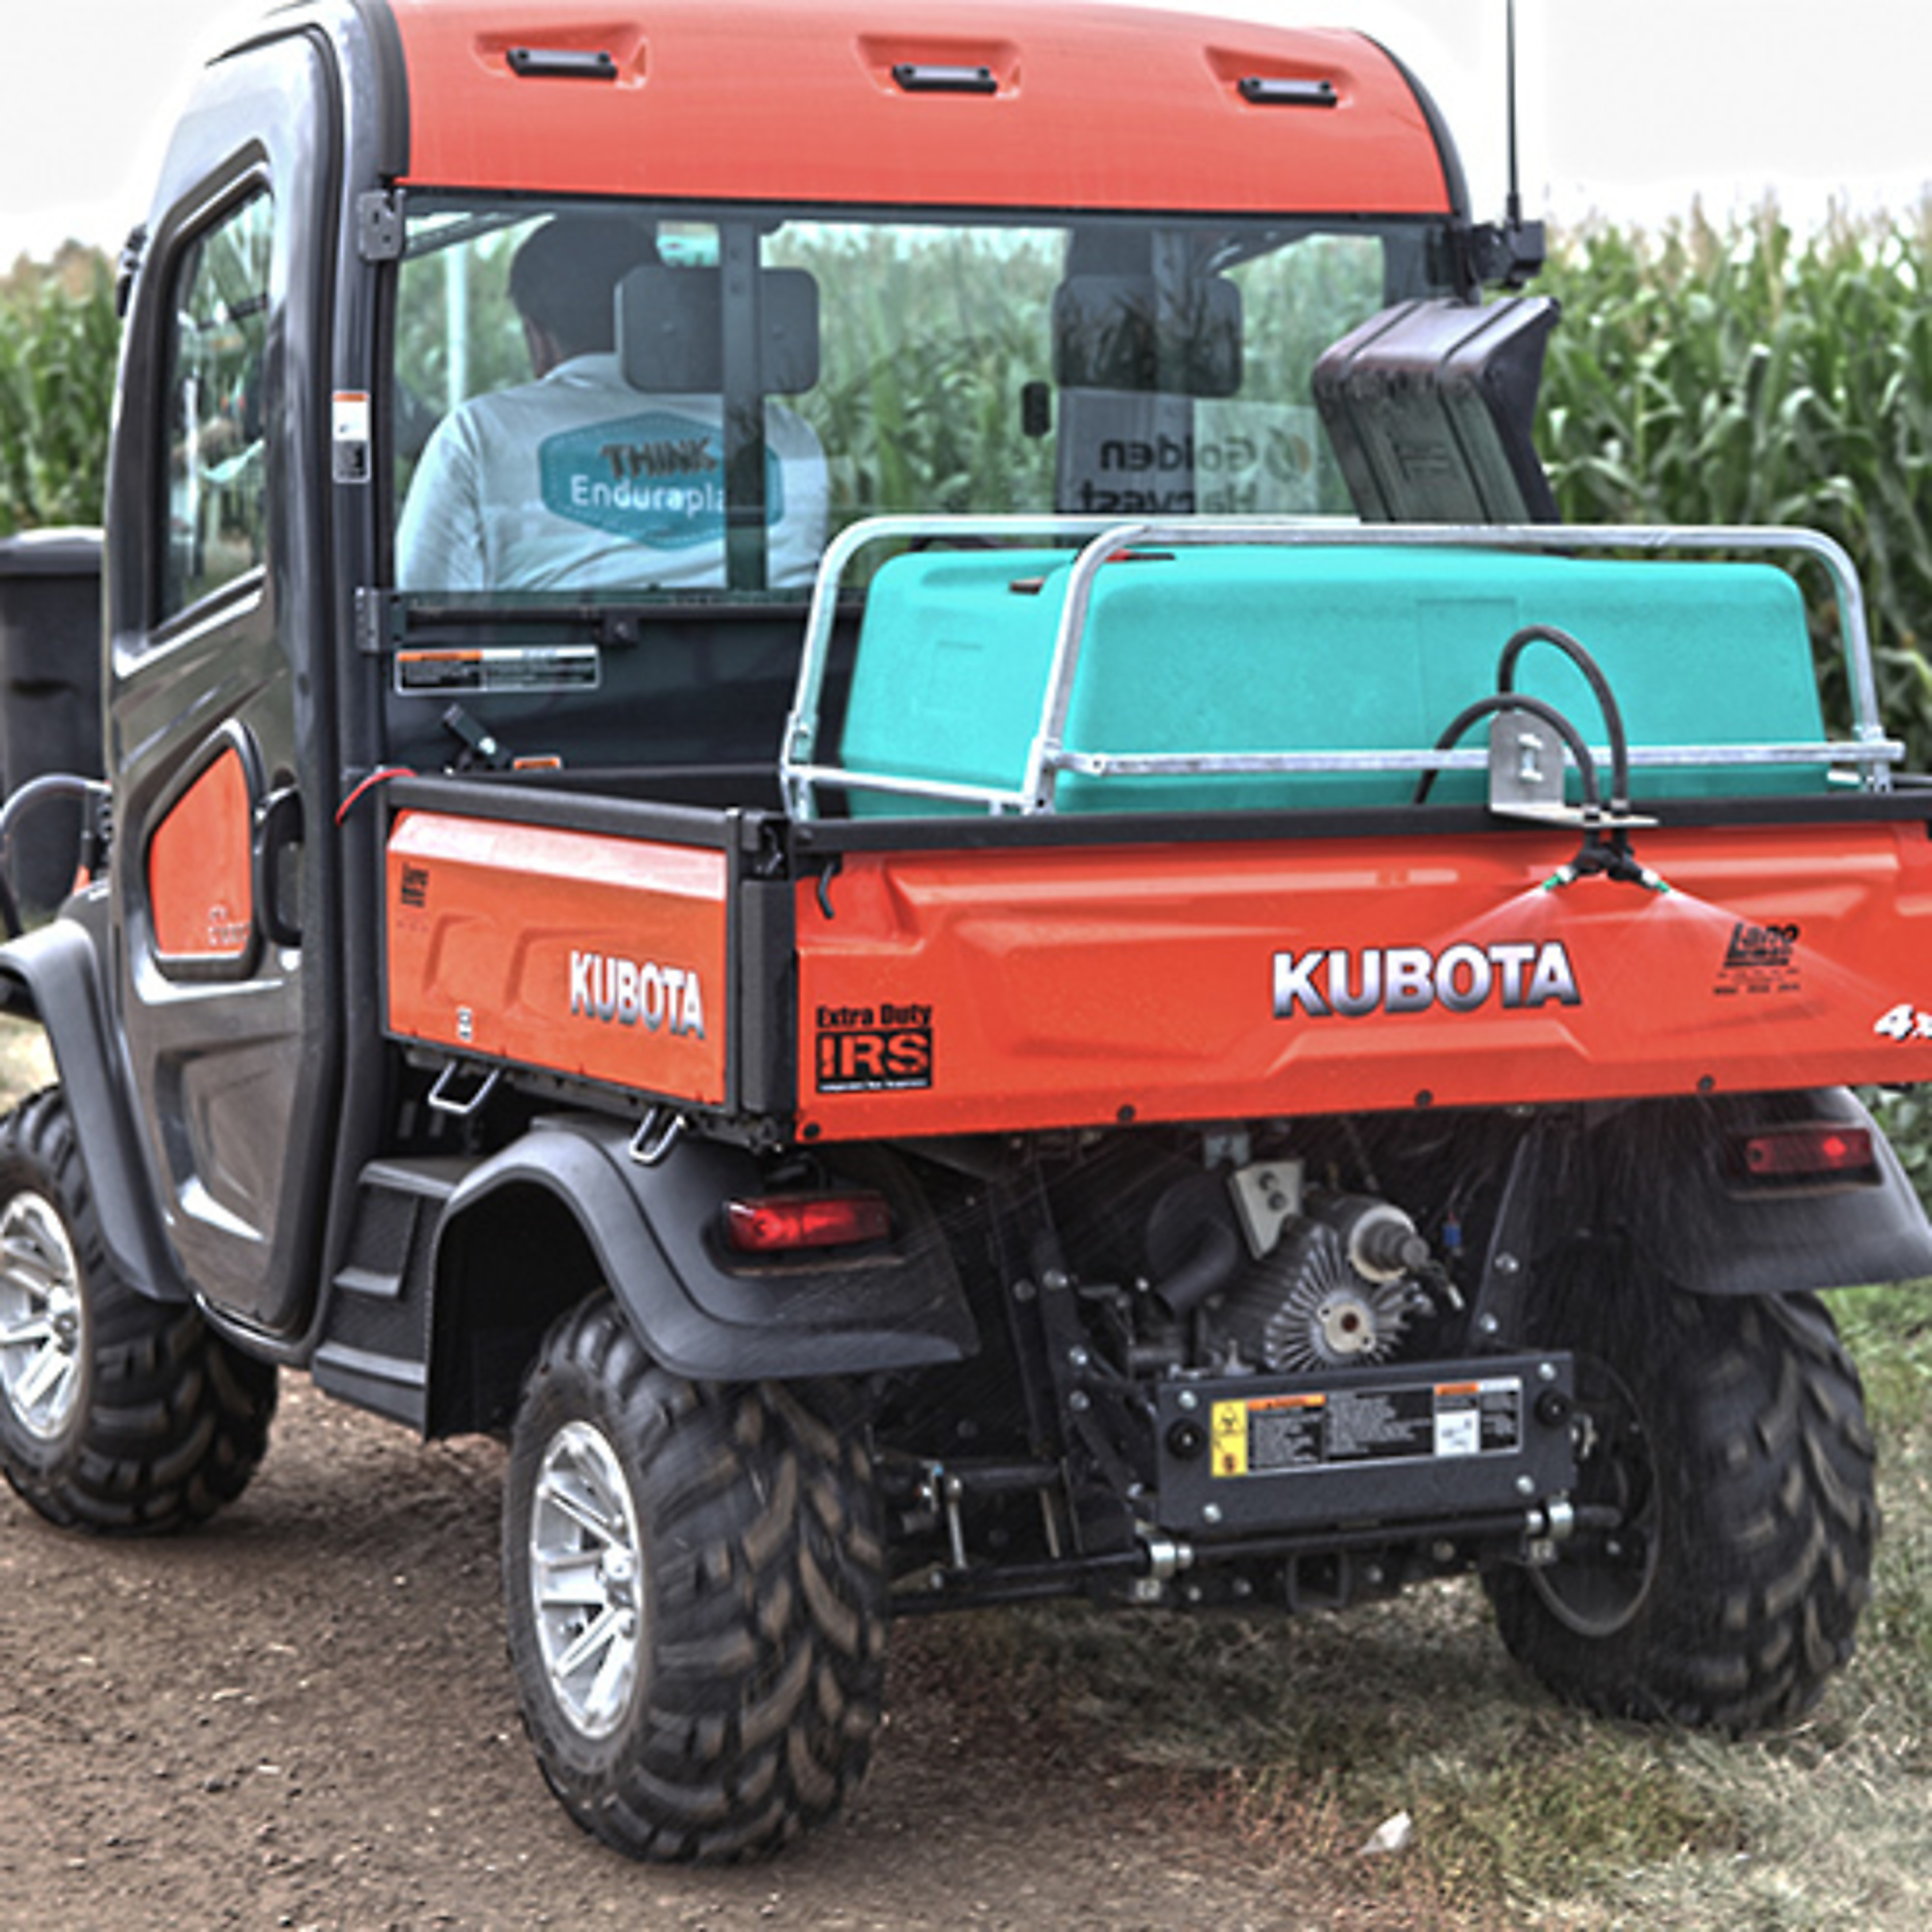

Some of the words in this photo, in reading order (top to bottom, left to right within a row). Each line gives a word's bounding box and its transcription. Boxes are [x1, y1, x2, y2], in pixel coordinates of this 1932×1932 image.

[600, 437, 718, 479] THINK
[568, 950, 705, 1039] KUBOTA
[1272, 942, 1581, 1018] KUBOTA
[817, 1006, 873, 1028] Extra
[821, 1032, 929, 1078] IRS
